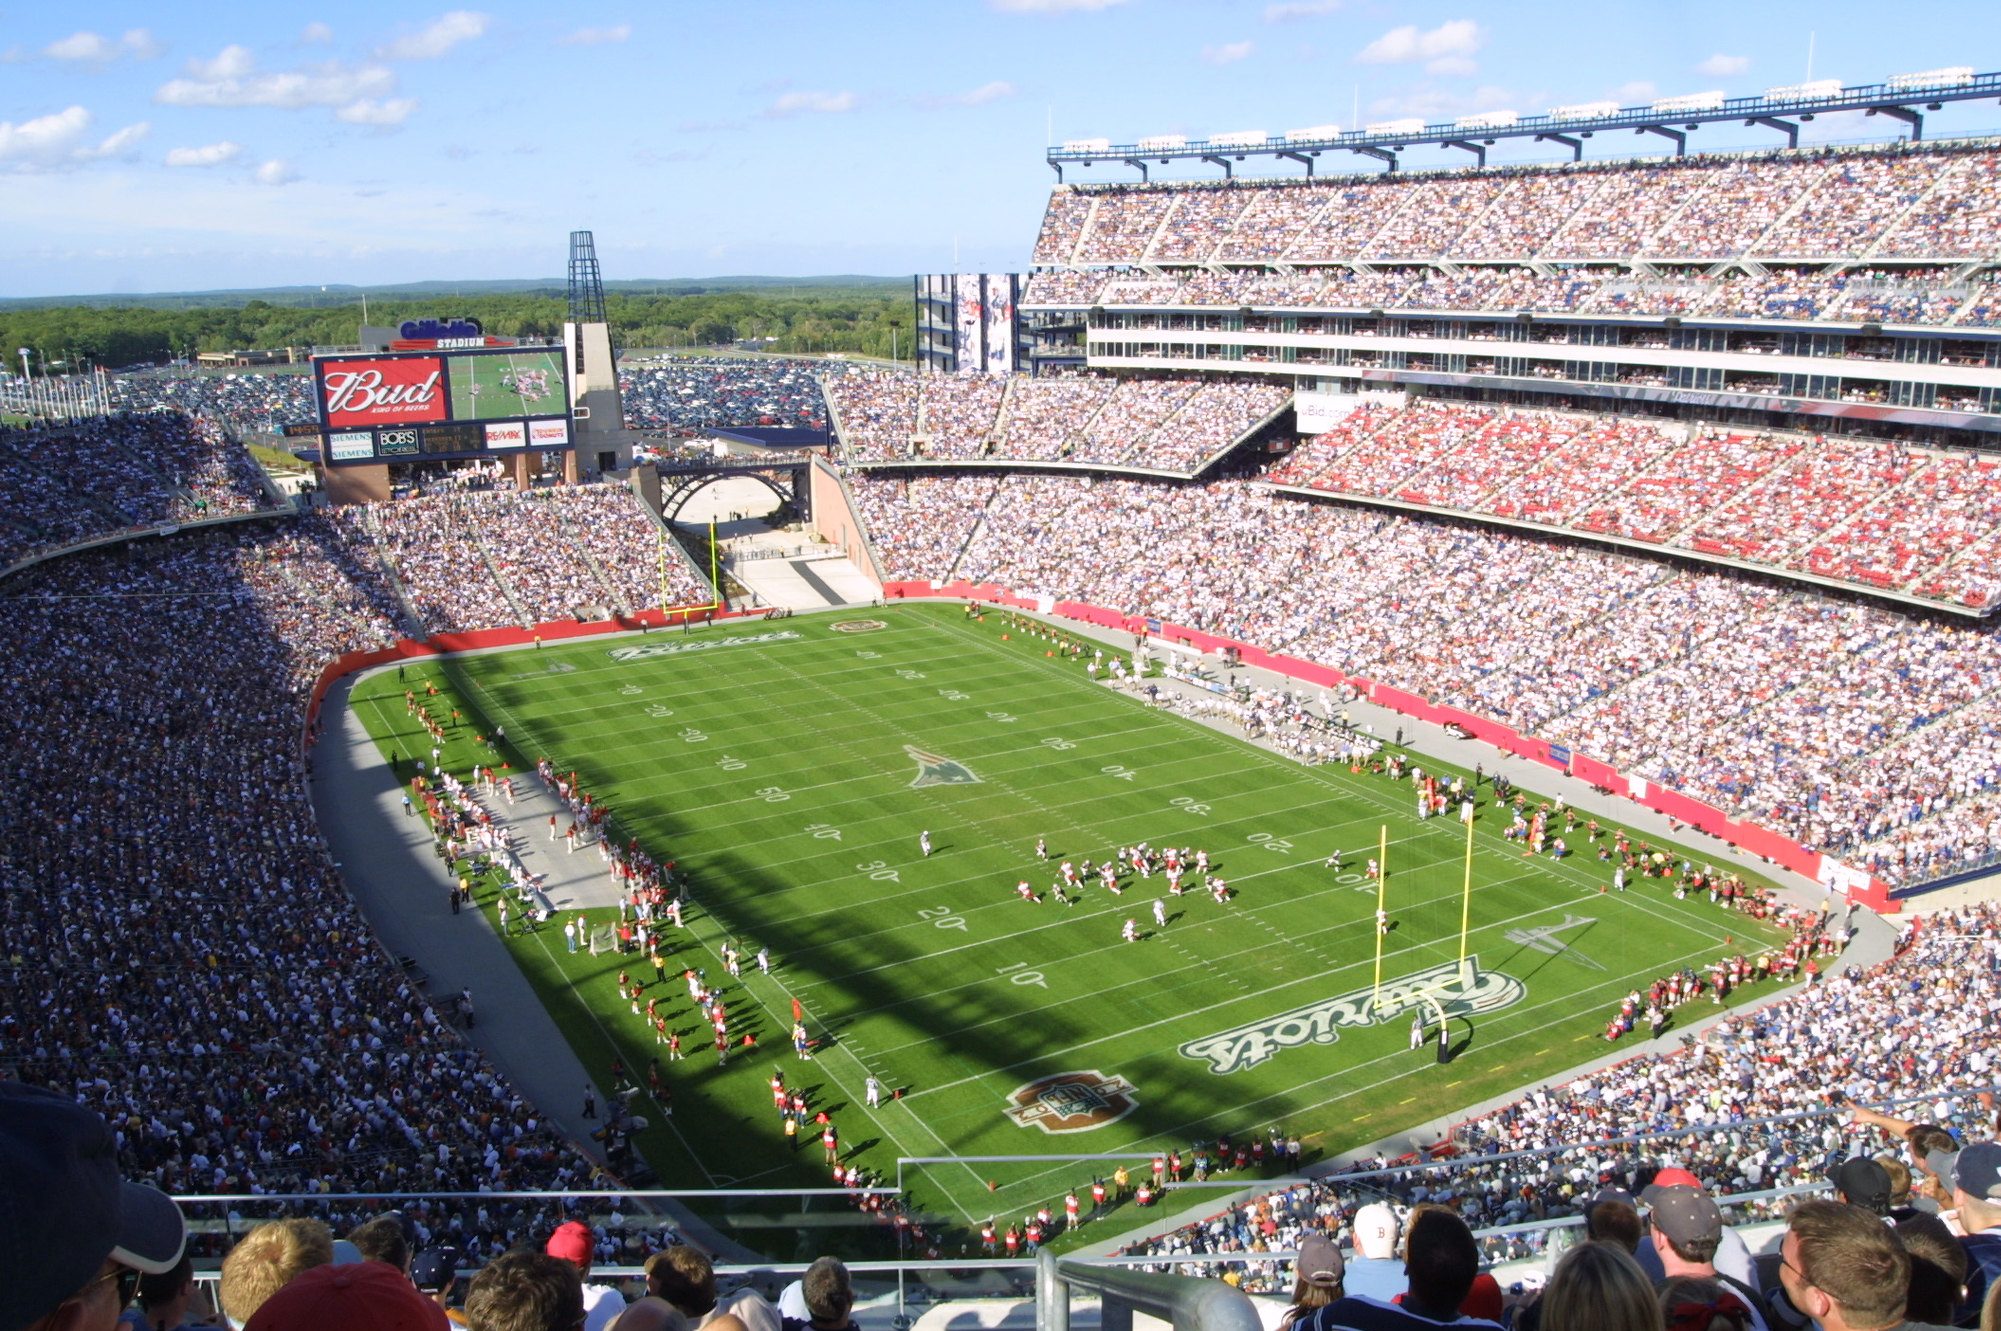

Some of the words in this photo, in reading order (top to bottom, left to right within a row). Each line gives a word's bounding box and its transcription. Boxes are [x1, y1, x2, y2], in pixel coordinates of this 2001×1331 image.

[436, 337, 485, 349] STADIUM
[325, 369, 440, 413] Bud
[330, 432, 373, 441] SIEMENS
[332, 449, 374, 458] SIEMENS
[644, 704, 674, 718] 20
[677, 727, 708, 743] 30
[1040, 737, 1077, 751] 50
[715, 754, 748, 771] 40
[1100, 765, 1137, 781] 40
[755, 786, 791, 803] 50
[1169, 797, 1212, 814] 30
[803, 823, 841, 839] 40
[1246, 832, 1294, 851] 20
[856, 860, 899, 881] 30
[917, 905, 966, 929] 20
[995, 961, 1045, 986] 10
[1377, 1226, 1385, 1239] B
